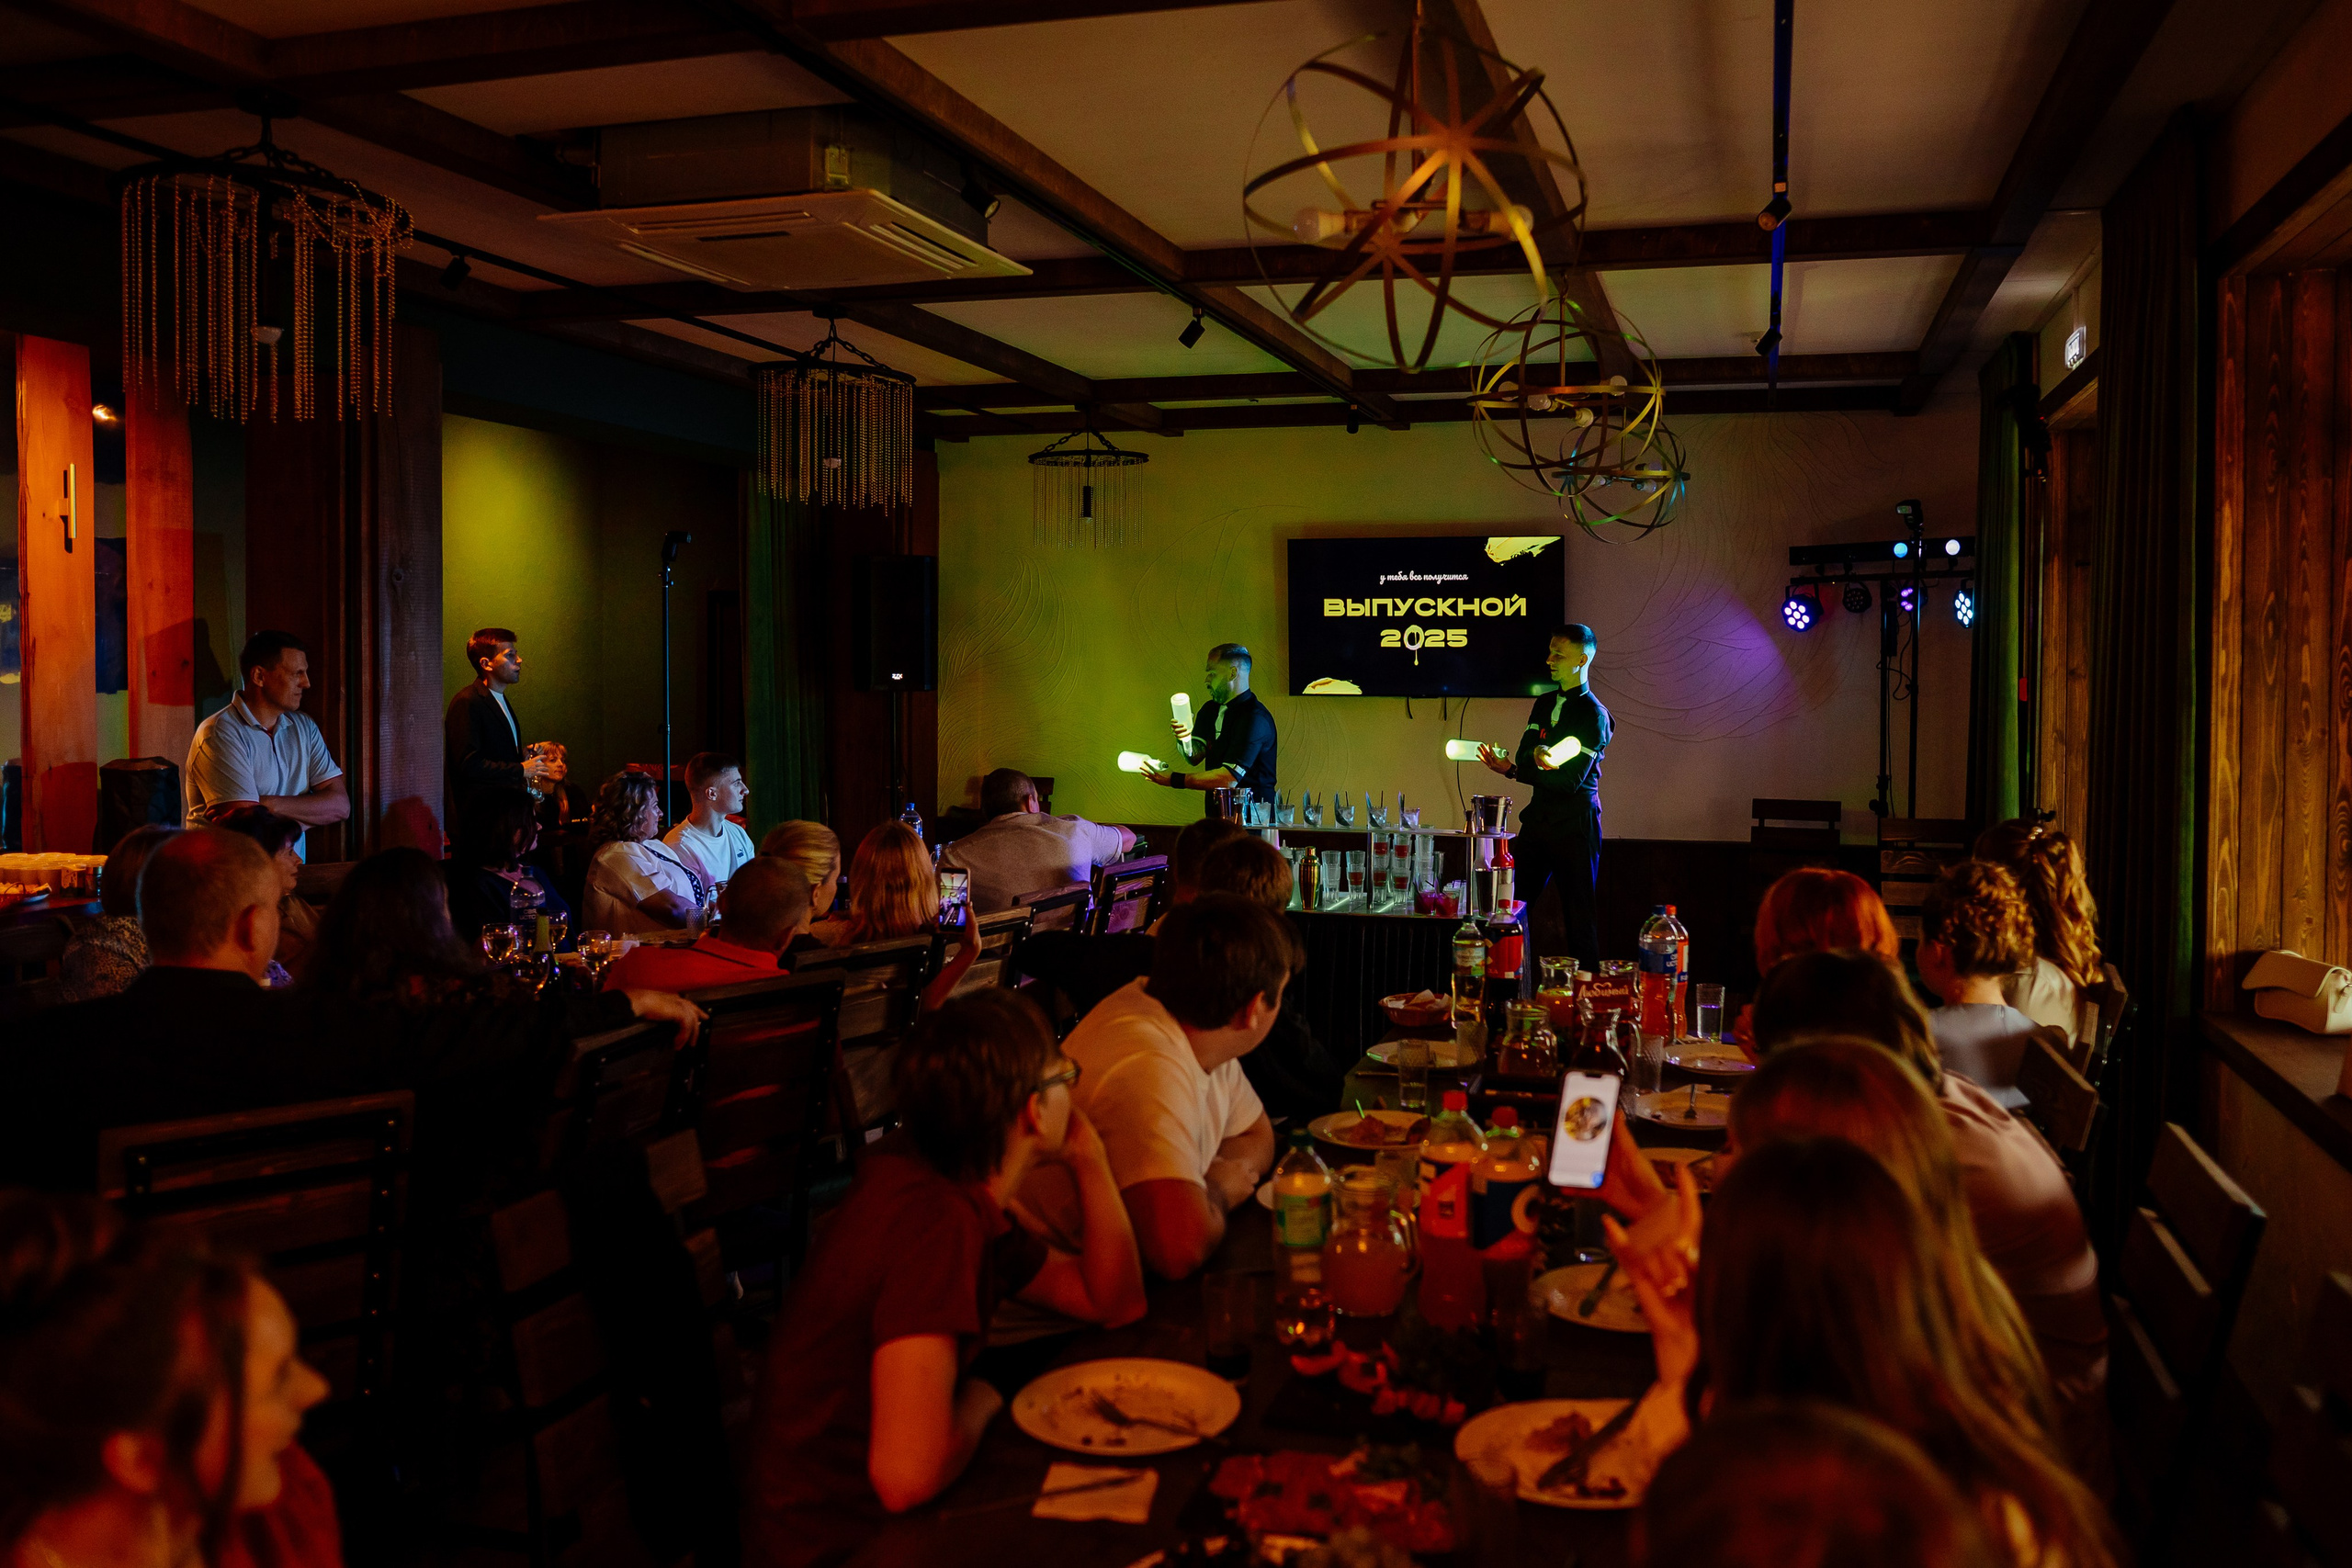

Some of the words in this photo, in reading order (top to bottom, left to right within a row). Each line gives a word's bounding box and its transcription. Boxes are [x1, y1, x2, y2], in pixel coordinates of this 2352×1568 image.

[1379, 574, 1386, 585] у
[1386, 570, 1408, 581] тебя
[1409, 570, 1422, 581] все
[1423, 573, 1469, 585] получится
[1323, 593, 1527, 617] ВЫПУСКНОЙ
[1380, 625, 1468, 650] 2025
